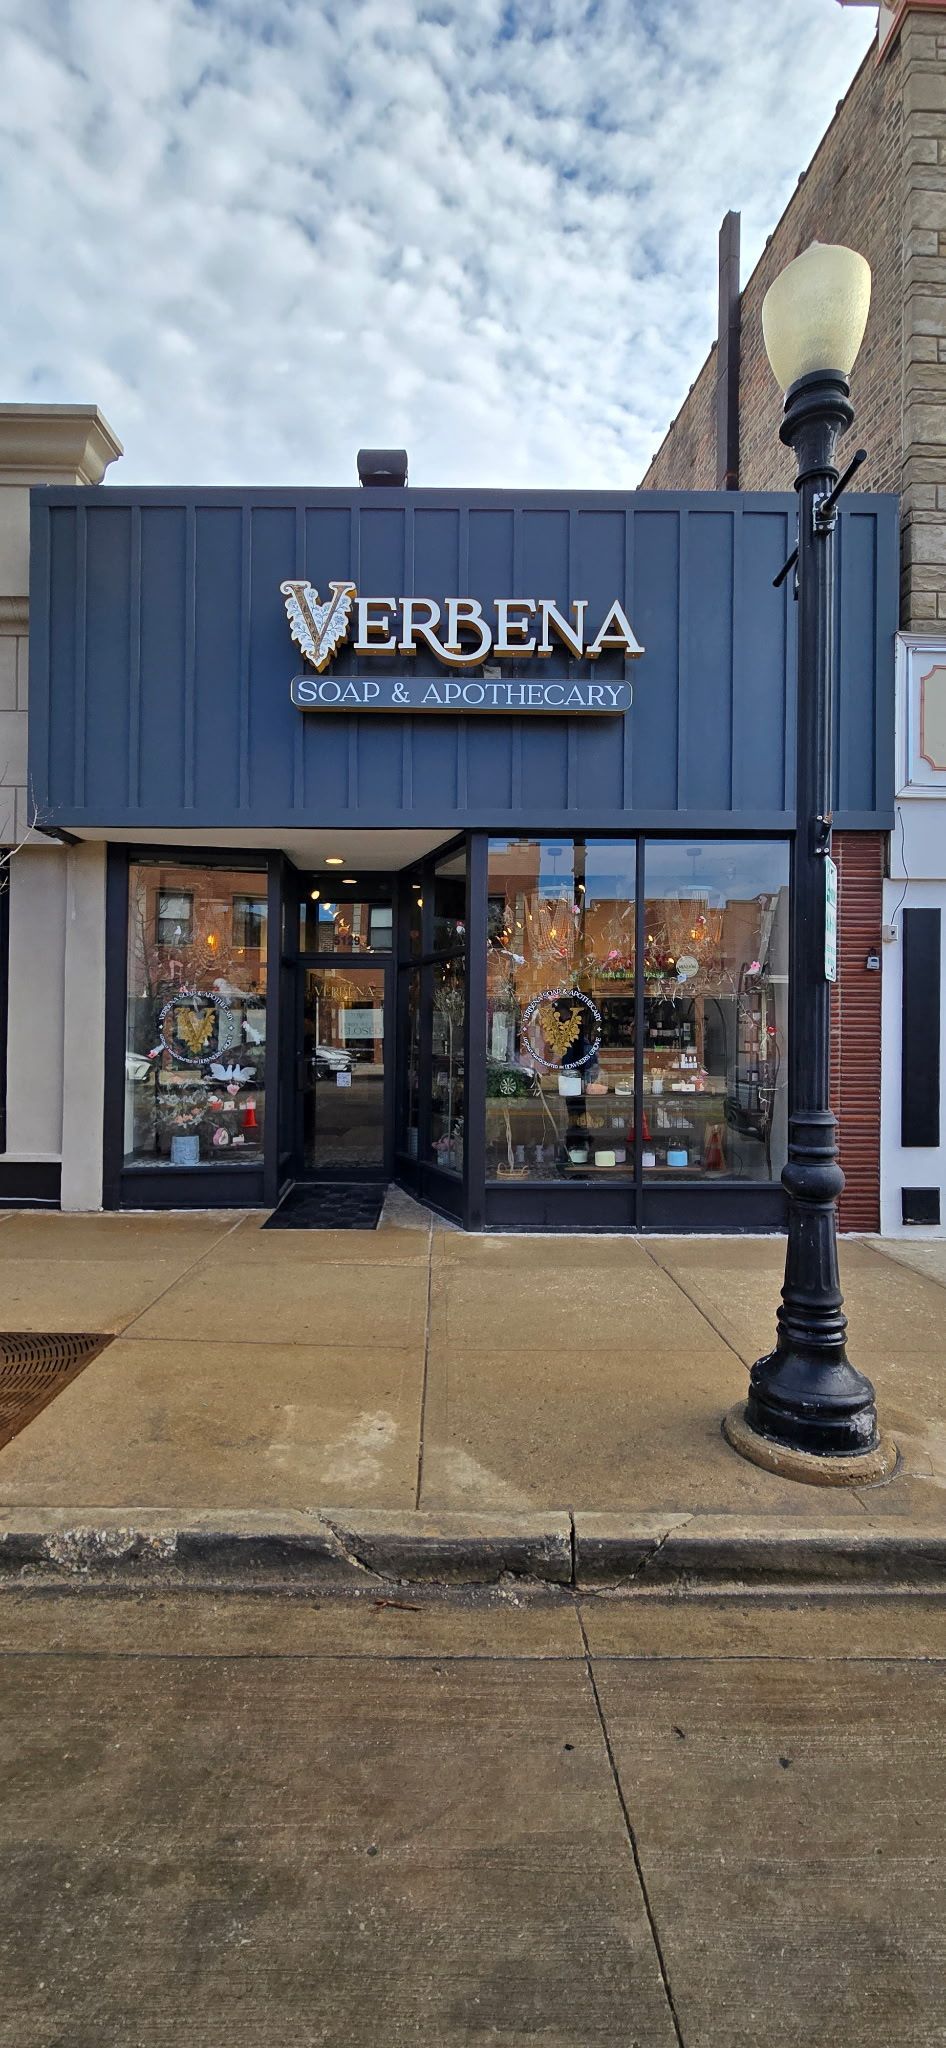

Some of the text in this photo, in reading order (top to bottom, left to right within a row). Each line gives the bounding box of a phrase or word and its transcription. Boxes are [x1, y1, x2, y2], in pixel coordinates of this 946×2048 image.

[280, 580, 645, 667] VERBENA
[297, 681, 625, 706] SOAP & APOTHECARY
[314, 986, 375, 997] VERBENA
[522, 993, 543, 1022] VERBENA
[543, 988, 561, 1000] SOAP
[569, 990, 602, 1021] APOTHECARY
[204, 992, 233, 1021] APOTHECARY
